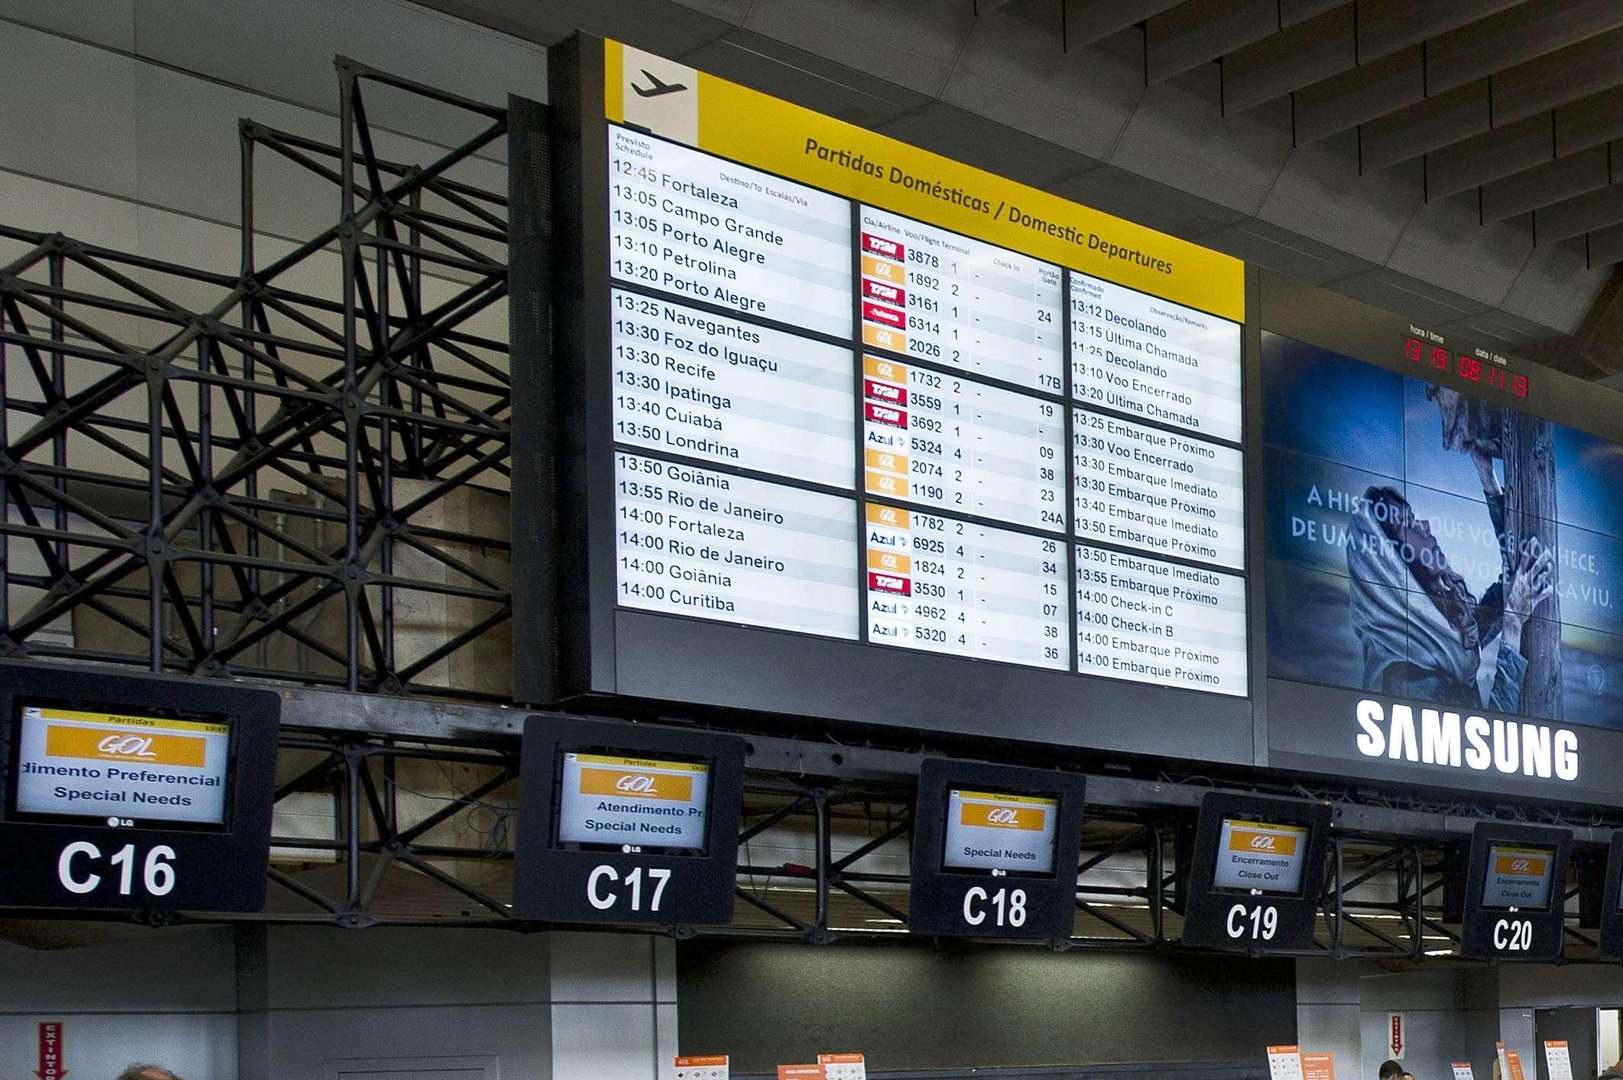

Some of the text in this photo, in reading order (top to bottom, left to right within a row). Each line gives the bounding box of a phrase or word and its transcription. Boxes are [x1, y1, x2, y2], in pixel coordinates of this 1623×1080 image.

[613, 160, 738, 209] 12:45 Fortaleza
[614, 185, 783, 246] 13:05 Campo Grande
[805, 138, 1173, 275] Partidas Domésticas / Domestic Departures
[614, 209, 765, 264] 13:05 Porto Alegre
[614, 235, 736, 280] 13:10 Petrolina
[908, 248, 939, 269] 3878
[615, 260, 766, 312] 13:20 Porto Alegre
[908, 272, 939, 291] 1892
[616, 295, 760, 344] 13:25 Navegantes
[909, 316, 939, 335] 6314
[1037, 310, 1051, 323] 24
[1071, 300, 1167, 338] 13:12 Decolando
[616, 320, 778, 373] 13:30 Foz do Iguaçu
[1410, 324, 1425, 337] hora
[1430, 333, 1444, 344] time
[616, 345, 716, 380] 13:30 Recife
[1475, 348, 1489, 360] data
[1493, 354, 1507, 366] date
[616, 371, 732, 410] 13:30 Ipatinga
[910, 371, 941, 389] 1732
[1039, 375, 1061, 389] 17B
[1106, 371, 1192, 405] Voo Encerrado
[617, 396, 723, 431] 13:40 Cuiabá
[911, 415, 942, 433] 3692
[1147, 404, 1199, 427] Chamada
[617, 421, 739, 459] 13:50 Londrina
[869, 431, 893, 446] Azul
[911, 438, 942, 455] 5324
[618, 456, 730, 491] 13:50 Goiânia
[1108, 463, 1218, 499] Embarque Imediato
[619, 481, 784, 525] 13:55 Rio de Janeiro
[912, 484, 943, 500] 1190
[1307, 485, 1322, 506] A
[620, 507, 745, 542] 14:00 Fortaleza
[913, 515, 944, 531] 1782
[1291, 516, 1316, 539] DE
[1322, 523, 1355, 550] UM
[620, 532, 785, 573] 14:00 Rio de Janeiro
[913, 537, 944, 553] 6925
[621, 557, 732, 587] 14:00 Goiânia
[621, 582, 735, 612] 14:00 Curitiba
[914, 582, 945, 598] 3530
[1076, 569, 1218, 605] 13:55 Embarque Próximo
[1077, 590, 1173, 617] 14:00 Check-in C
[915, 627, 946, 642] 5320
[108, 716, 155, 726] Partidas
[98, 735, 157, 757] GOL
[1355, 699, 1579, 782] SAMSUNG
[107, 769, 220, 787] Preferencial
[616, 776, 657, 793] GOL
[54, 787, 192, 806] Special Needs
[597, 802, 684, 816] Atendimento
[121, 819, 134, 827] LG
[585, 820, 682, 835] Special Needs
[964, 847, 1036, 860] Special Needs
[1232, 855, 1289, 867] Encerramento
[58, 841, 176, 896] C16
[1238, 871, 1279, 880] Close Out
[587, 865, 671, 912] C17
[963, 886, 1027, 927] C18
[1227, 904, 1278, 940] C19
[1494, 919, 1533, 951] C20
